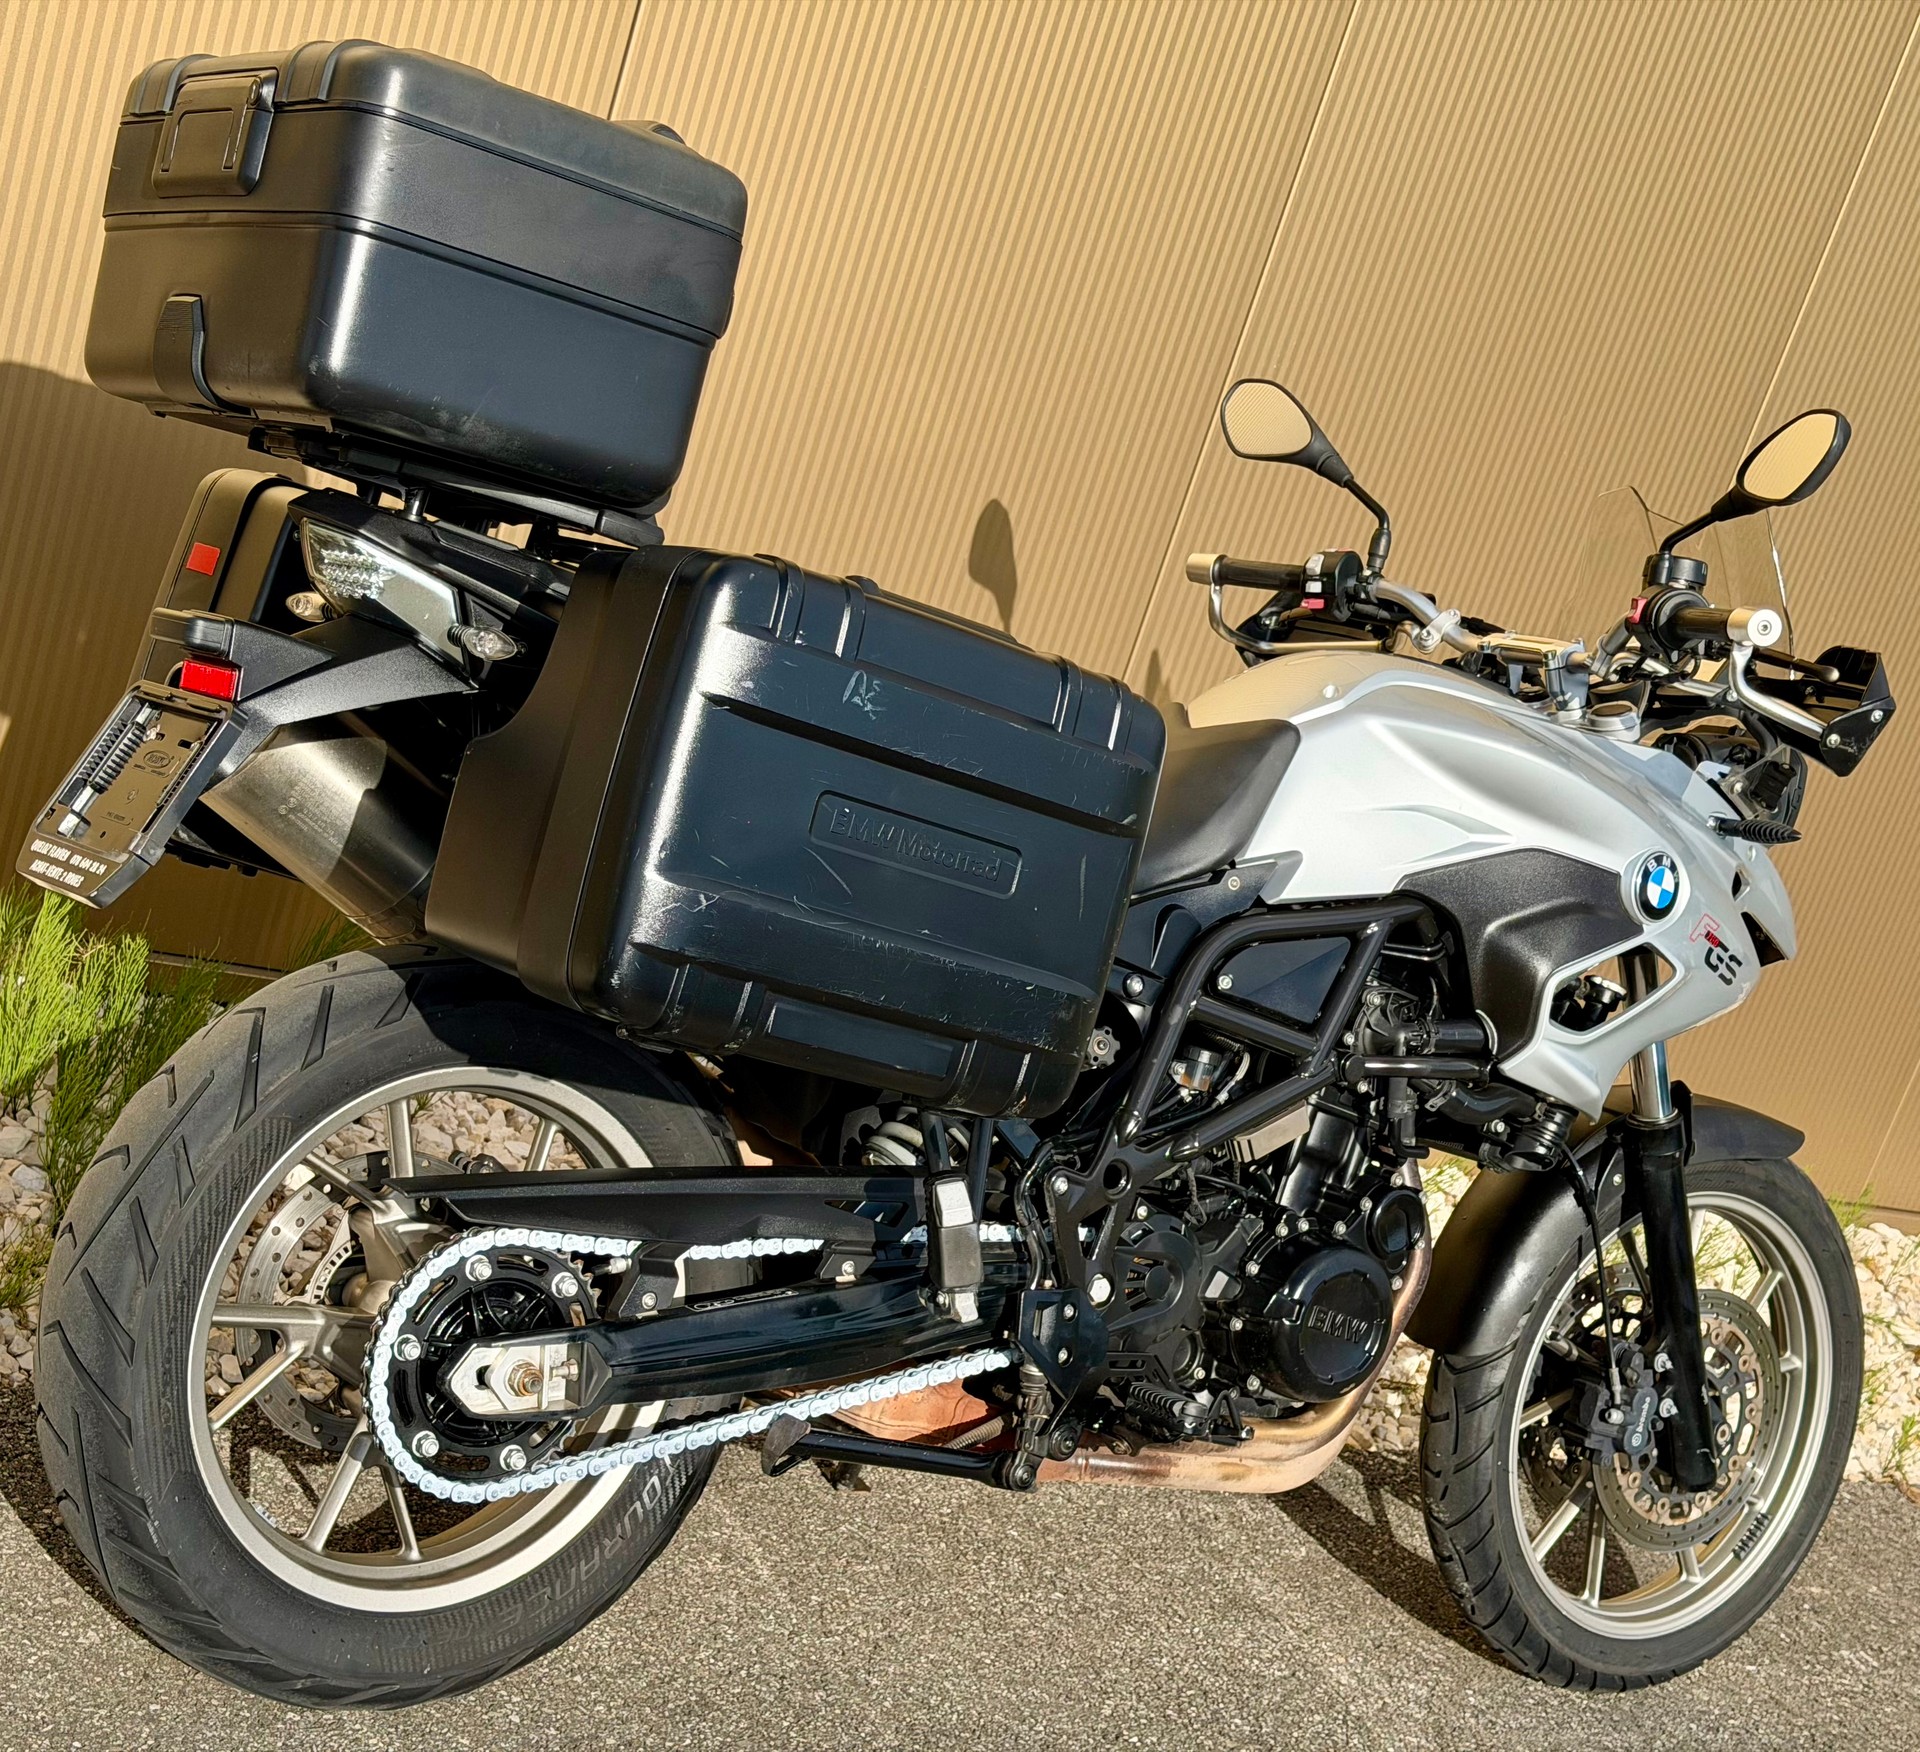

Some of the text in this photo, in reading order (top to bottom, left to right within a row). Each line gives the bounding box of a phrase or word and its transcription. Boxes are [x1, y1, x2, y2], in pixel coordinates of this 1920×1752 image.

[829, 808, 1002, 881] BMW Motorrad
[1647, 855, 1680, 883] BMW
[1704, 946, 1743, 986] GS
[1308, 1305, 1368, 1343] BMW
[1635, 1396, 1651, 1432] brembo
